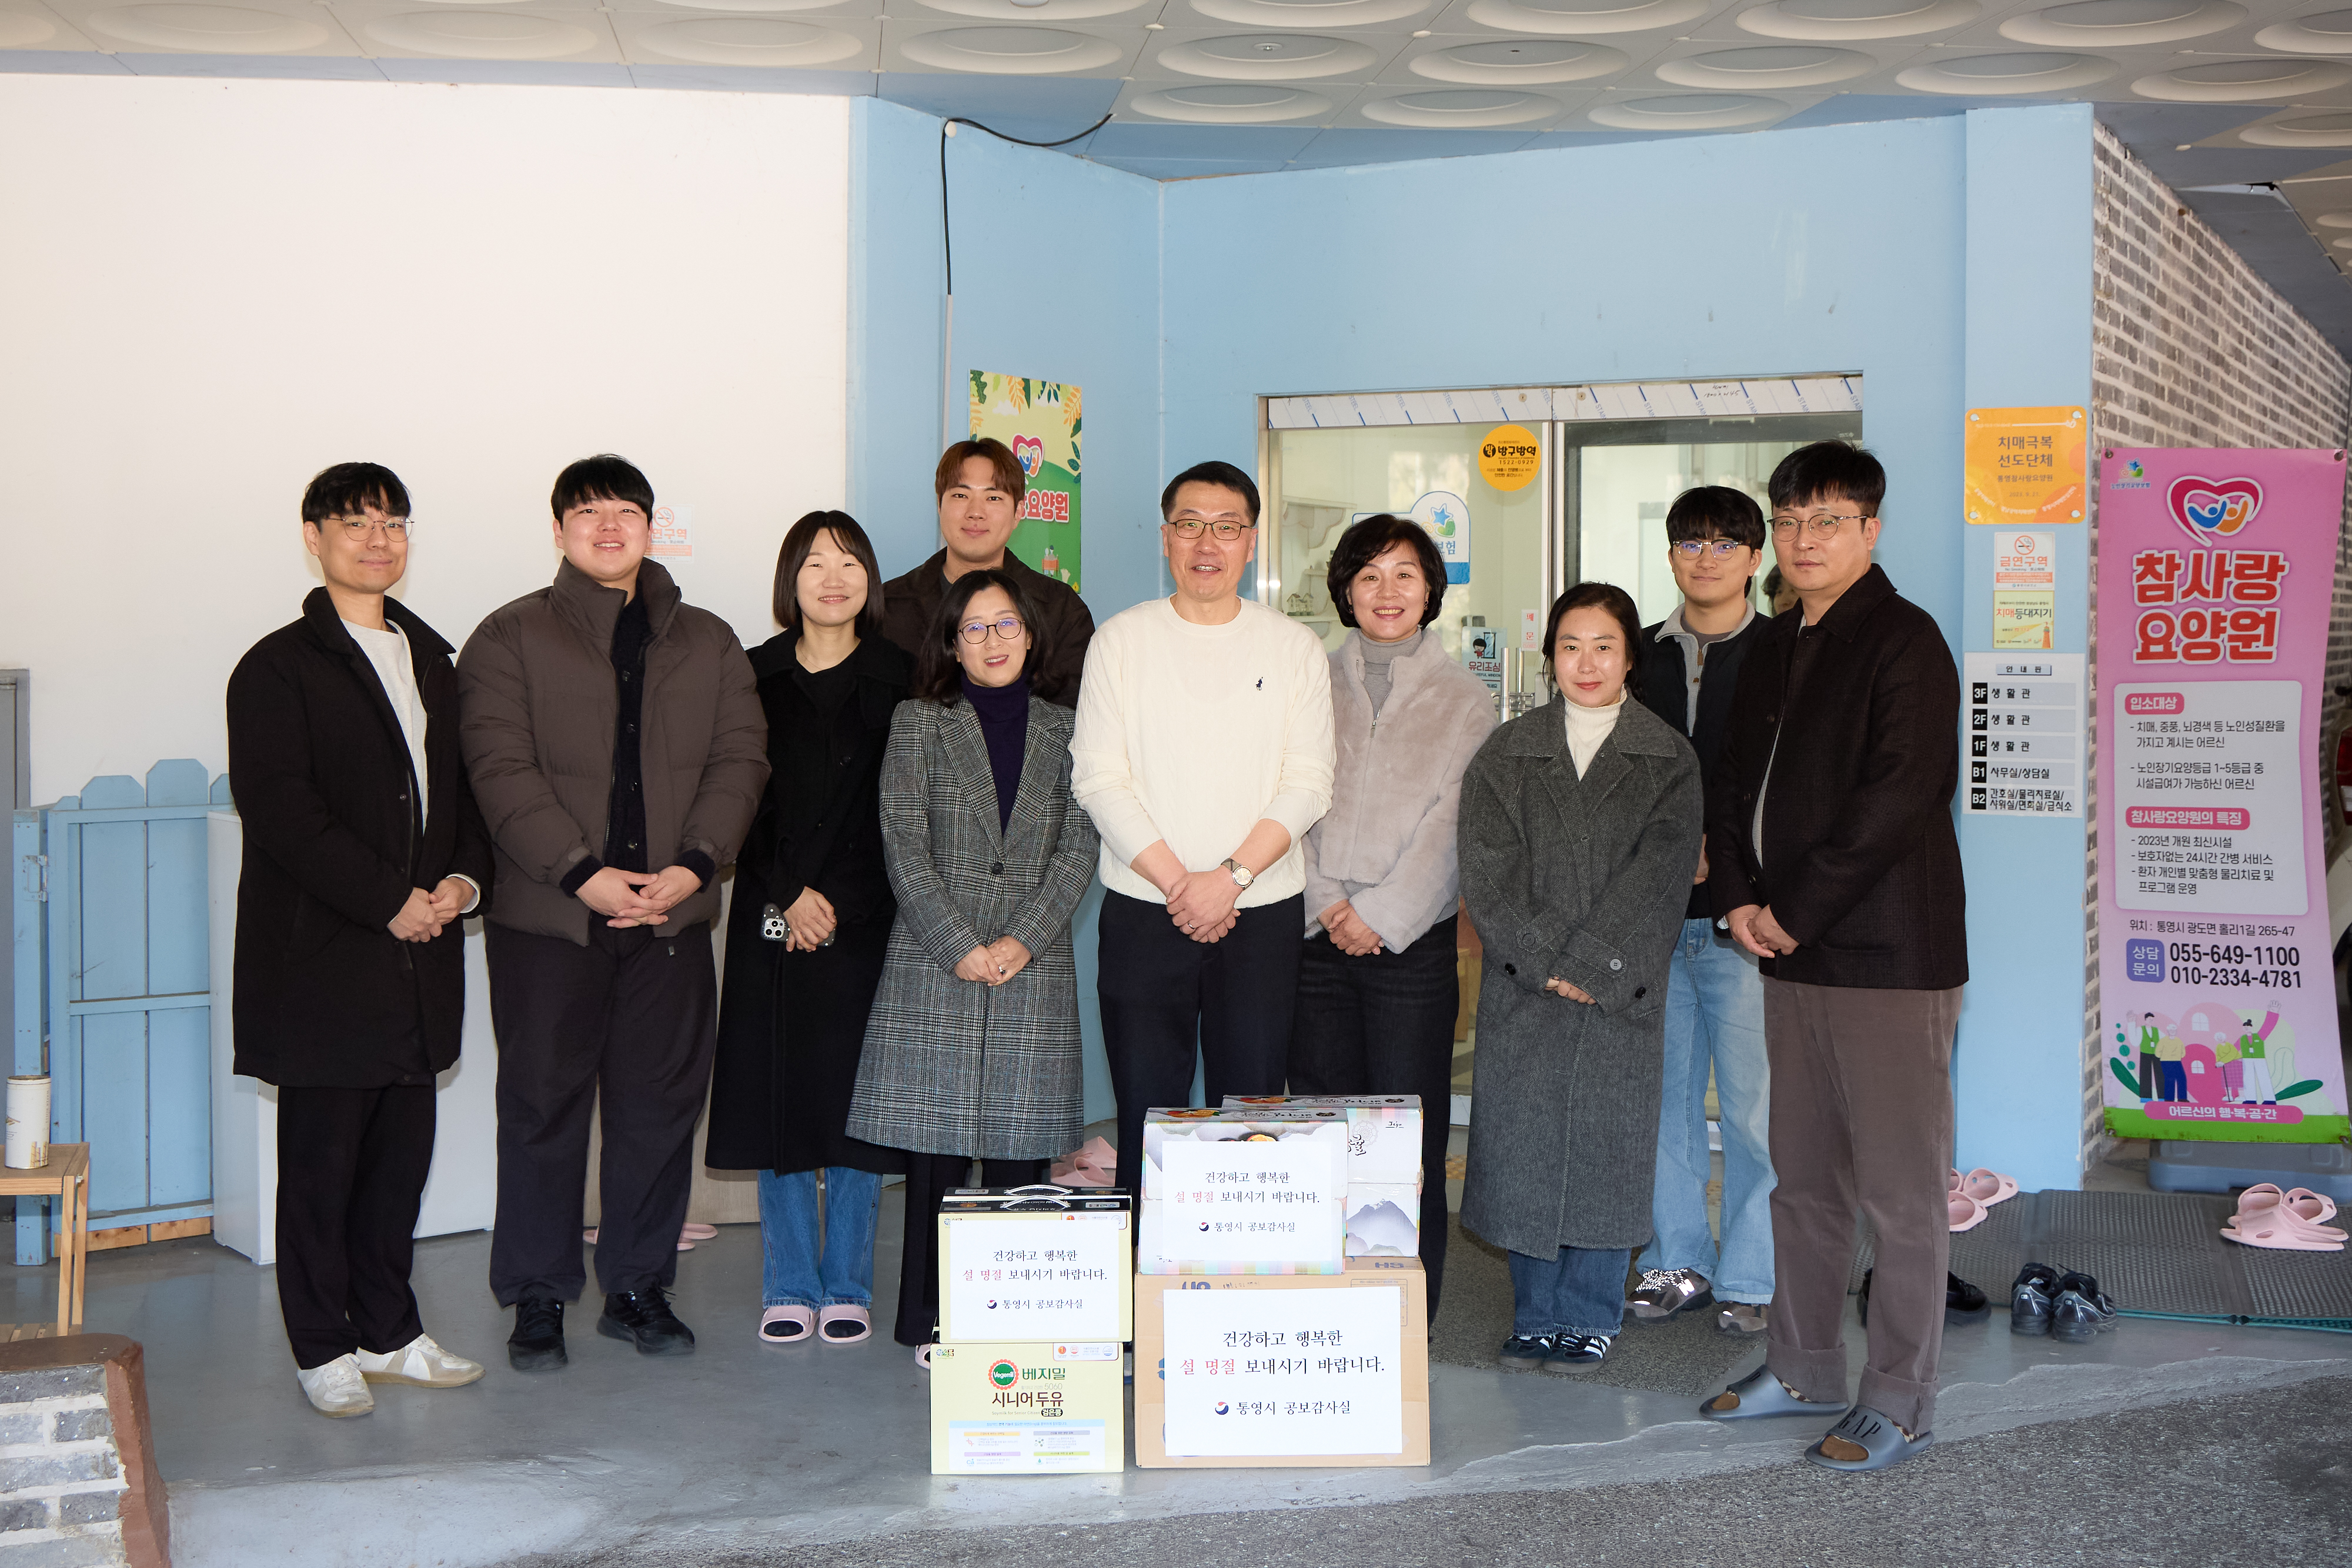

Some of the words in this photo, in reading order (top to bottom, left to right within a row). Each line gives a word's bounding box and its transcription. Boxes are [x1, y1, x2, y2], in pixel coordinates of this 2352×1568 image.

[1396, 393, 1405, 409] STEEL
[1443, 392, 1454, 407] STEEL
[1492, 390, 1502, 405] STEEL
[1541, 388, 1551, 404] STEEL
[1302, 397, 1312, 412] STEEL
[1349, 396, 1358, 410] STEEL
[1999, 436, 2053, 449] 치매극복
[1498, 446, 1536, 456] 방구방역
[1999, 454, 2053, 467] 선도단체
[1024, 490, 1070, 522] 요양원
[2000, 556, 2047, 567] 금연구역
[2134, 551, 2288, 605] 참사랑
[1996, 609, 2052, 620] 치매등대지기
[2134, 609, 2279, 663] 요양원
[1469, 661, 1500, 672] 유리조심
[1974, 688, 1986, 698] 3F
[2130, 697, 2177, 711] 입소대상
[1974, 715, 1986, 725] 2F
[2137, 721, 2157, 733] 치매,
[2160, 721, 2181, 733] 중풍,
[2183, 721, 2211, 732] 뇌경색
[2214, 721, 2223, 732] 등
[2226, 720, 2285, 732] 노인성질환을
[1974, 741, 1986, 751] 1F
[2136, 737, 2163, 748] 가지고
[2166, 737, 2194, 748] 계시는
[2197, 737, 2225, 748] 어르신
[1973, 767, 1985, 777] B1
[1991, 768, 2050, 779] 사무실/상담실
[2137, 763, 2211, 774] 노인장기요양등급
[2214, 763, 2251, 774] 1~5등급
[2254, 763, 2264, 774] 중
[2136, 778, 2182, 789] 시설급여가
[2184, 778, 2222, 790] 가능하신
[2225, 778, 2254, 790] 어르신
[1973, 794, 1986, 804] B2
[2132, 810, 2213, 824] 참사랑요양원의
[2216, 812, 2241, 825] 특징
[2138, 836, 2170, 847] 2023년
[2173, 836, 2190, 847] 개원
[2193, 837, 2232, 848] 최신시설
[2138, 851, 2184, 862] 보호자없는
[2186, 852, 2217, 864] 24시간
[2220, 853, 2239, 864] 간병
[2243, 854, 2273, 865] 서비스
[2138, 866, 2156, 877] 환자
[2159, 867, 2186, 879] 개인별
[2189, 868, 2217, 880] 맞춤형
[2220, 869, 2261, 881] 물리치료
[2264, 870, 2274, 881] 및
[2139, 882, 2176, 894] 프로그램
[2178, 883, 2197, 895] 운영
[2157, 921, 2184, 934] 통영시
[2187, 922, 2216, 935] 광도면
[2219, 924, 2256, 936] 홀리1길
[2259, 925, 2295, 937] 265-47
[2133, 946, 2159, 960] 상담
[2170, 942, 2300, 966] 055-649-1100
[2133, 963, 2159, 977] 문의
[2171, 967, 2301, 988] 010-2334-4781
[2169, 1106, 2216, 1118] 어르신의
[1205, 1172, 1250, 1183] 건강하고
[1257, 1171, 1290, 1183] 행복한
[1175, 1191, 1185, 1203] 설
[1192, 1191, 1214, 1203] 명절
[1221, 1191, 1265, 1203] 보내시기
[1272, 1191, 1319, 1203] 바랍니다.
[1214, 1222, 1242, 1232] 통영시
[1248, 1221, 1295, 1232] 공보감사실
[993, 1250, 1038, 1262] 건강하고
[1044, 1250, 1078, 1261] 행복한
[963, 1269, 974, 1281] 설
[981, 1269, 1001, 1281] 명절
[1008, 1269, 1053, 1281] 보내시기
[1060, 1269, 1107, 1281] 바랍니다.
[1003, 1299, 1030, 1309] 통영시
[1036, 1299, 1083, 1309] 공보감사실
[1223, 1331, 1287, 1347] 건강하고
[1295, 1330, 1343, 1347] 행복한
[1180, 1359, 1194, 1375] 설
[1205, 1359, 1235, 1375] 명절
[1245, 1359, 1307, 1375] 보내시기
[1318, 1357, 1385, 1374] 바랍니다.
[1022, 1368, 1065, 1380] 베지밀
[992, 1392, 1033, 1407] 시니어
[1035, 1392, 1064, 1407] 두유
[1237, 1402, 1275, 1415] 통영시
[1284, 1401, 1351, 1415] 공보감사실
[1838, 1411, 1882, 1439] GAP
